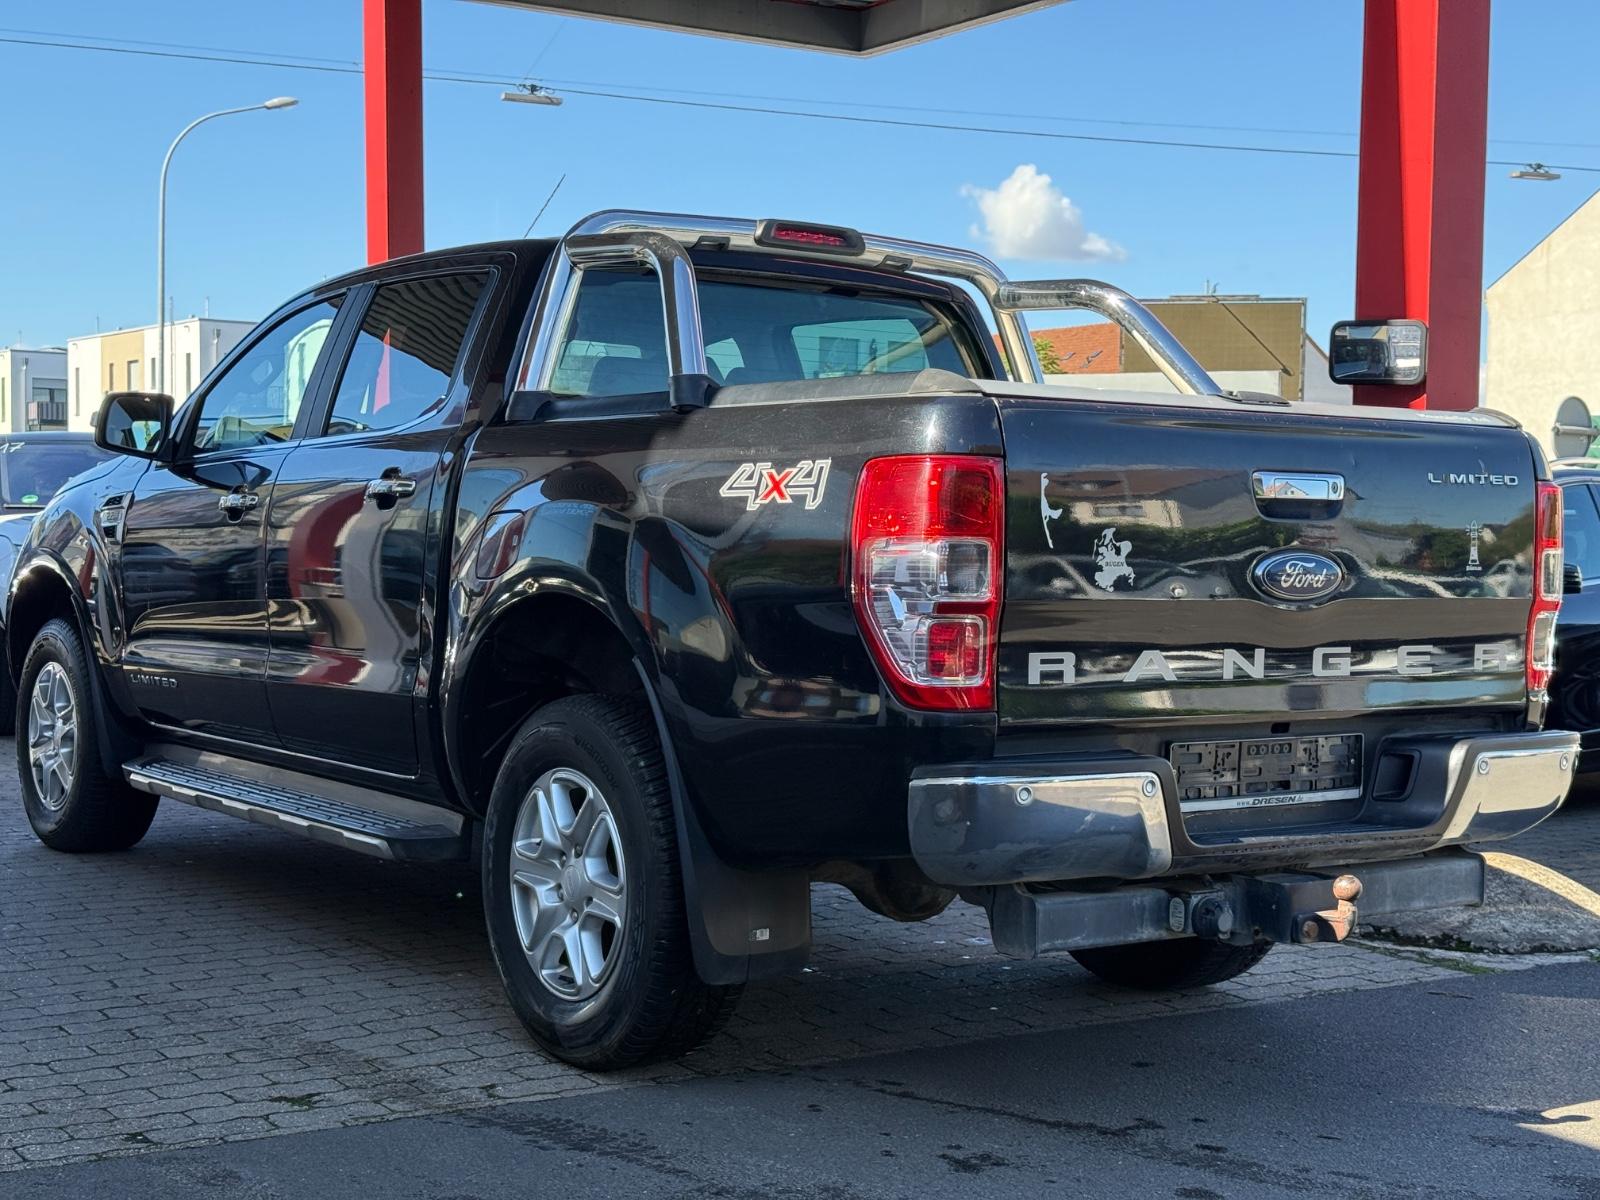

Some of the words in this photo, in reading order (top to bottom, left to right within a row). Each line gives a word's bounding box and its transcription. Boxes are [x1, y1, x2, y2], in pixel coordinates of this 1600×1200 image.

[1427, 472, 1519, 486] LIMITED
[1280, 560, 1327, 588] Ford
[1027, 643, 1508, 685] RANGER
[130, 673, 178, 688] LIMITED
